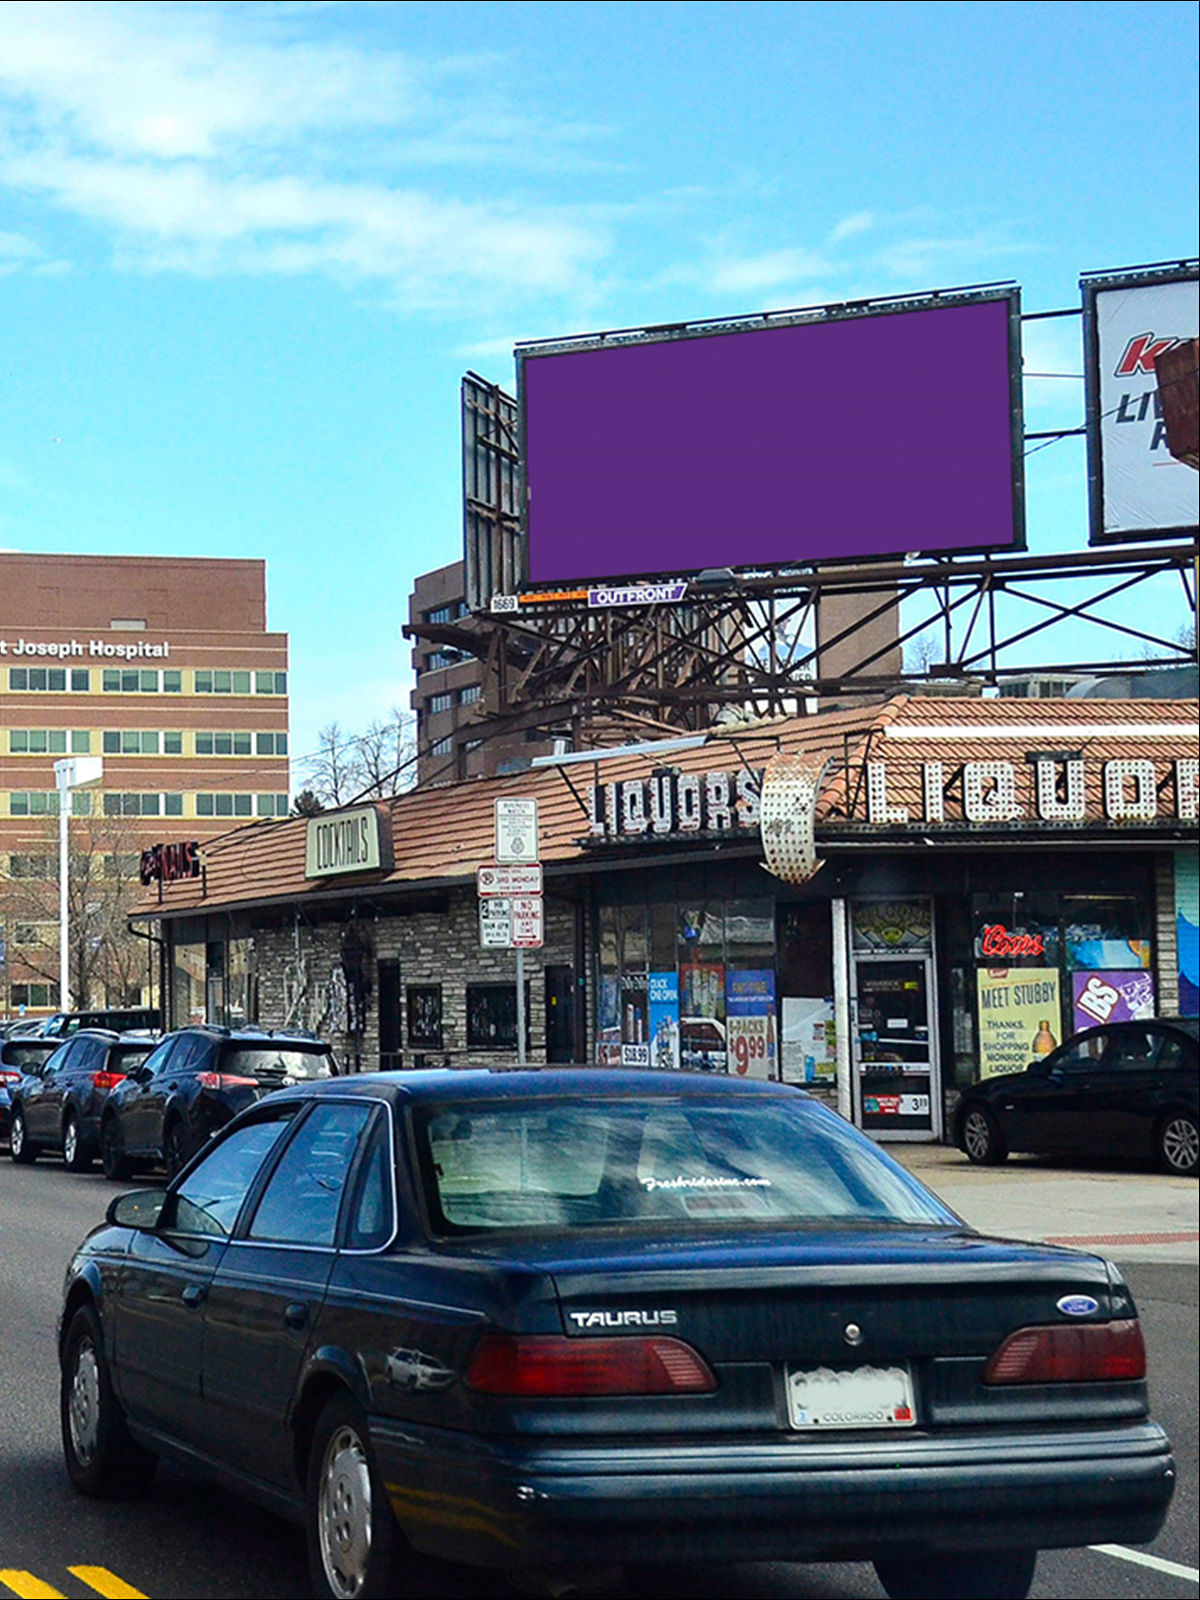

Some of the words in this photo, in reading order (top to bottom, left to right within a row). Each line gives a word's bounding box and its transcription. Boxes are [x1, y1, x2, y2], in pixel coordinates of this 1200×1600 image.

[597, 588, 675, 604] OUTFRONT
[12, 639, 83, 659] Joseph
[89, 640, 170, 660] Hospital
[584, 767, 761, 837] LIQUORS
[316, 816, 368, 870] COCKTAILS
[521, 902, 533, 910] NO
[513, 911, 541, 919] PARKING
[982, 924, 1044, 957] Coors
[981, 987, 1009, 1009] MEET
[1013, 980, 1057, 1006] STUBBY
[987, 1020, 1024, 1029] THANKS
[996, 1031, 1016, 1040] FOR
[983, 1042, 1030, 1051] SHOPPING
[987, 1053, 1026, 1062] MONROE
[989, 1064, 1024, 1073] LIQUOR
[570, 1310, 677, 1327] TAURUS
[823, 1410, 884, 1422] COLORADO
